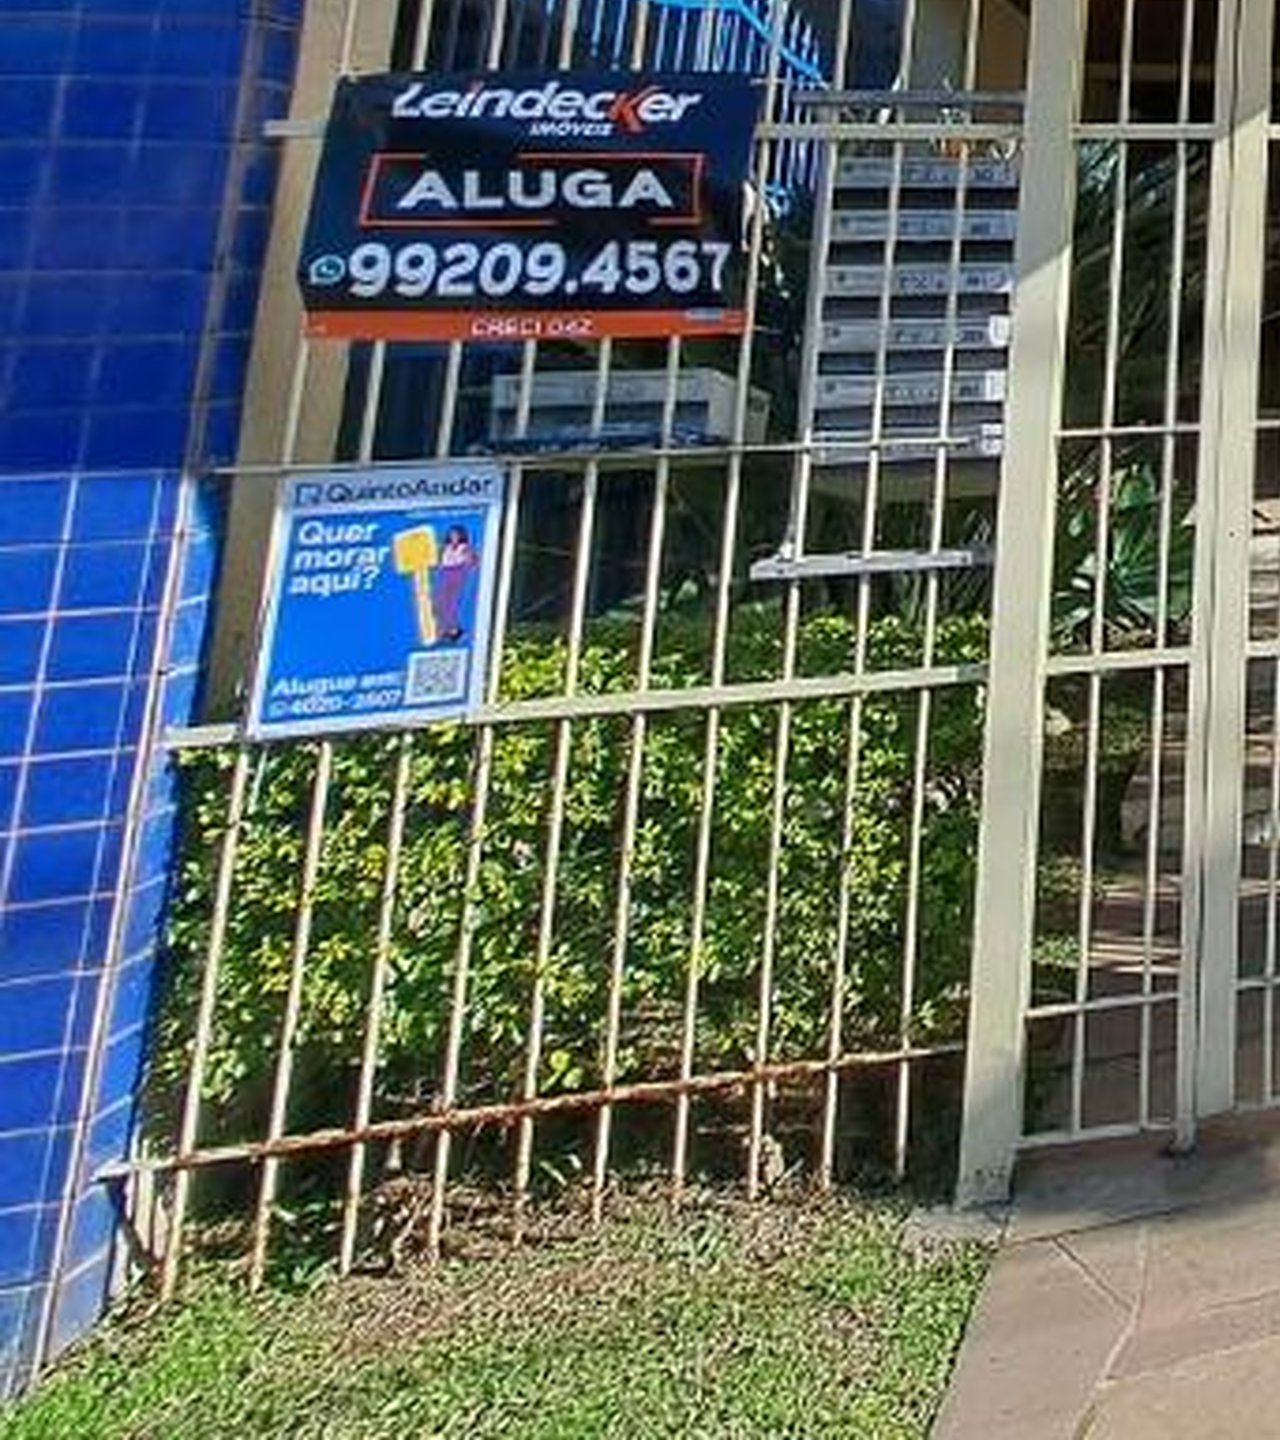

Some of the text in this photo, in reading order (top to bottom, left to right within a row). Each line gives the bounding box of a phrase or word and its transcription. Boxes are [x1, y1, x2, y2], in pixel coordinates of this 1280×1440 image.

[393, 81, 702, 133] Leindecker
[397, 169, 673, 209] ALUGA
[347, 240, 732, 297] 99209.4567
[325, 477, 493, 504] QuintoAndar
[299, 522, 379, 546] Quer
[294, 547, 389, 569] morar
[290, 566, 380, 597] aqui?
